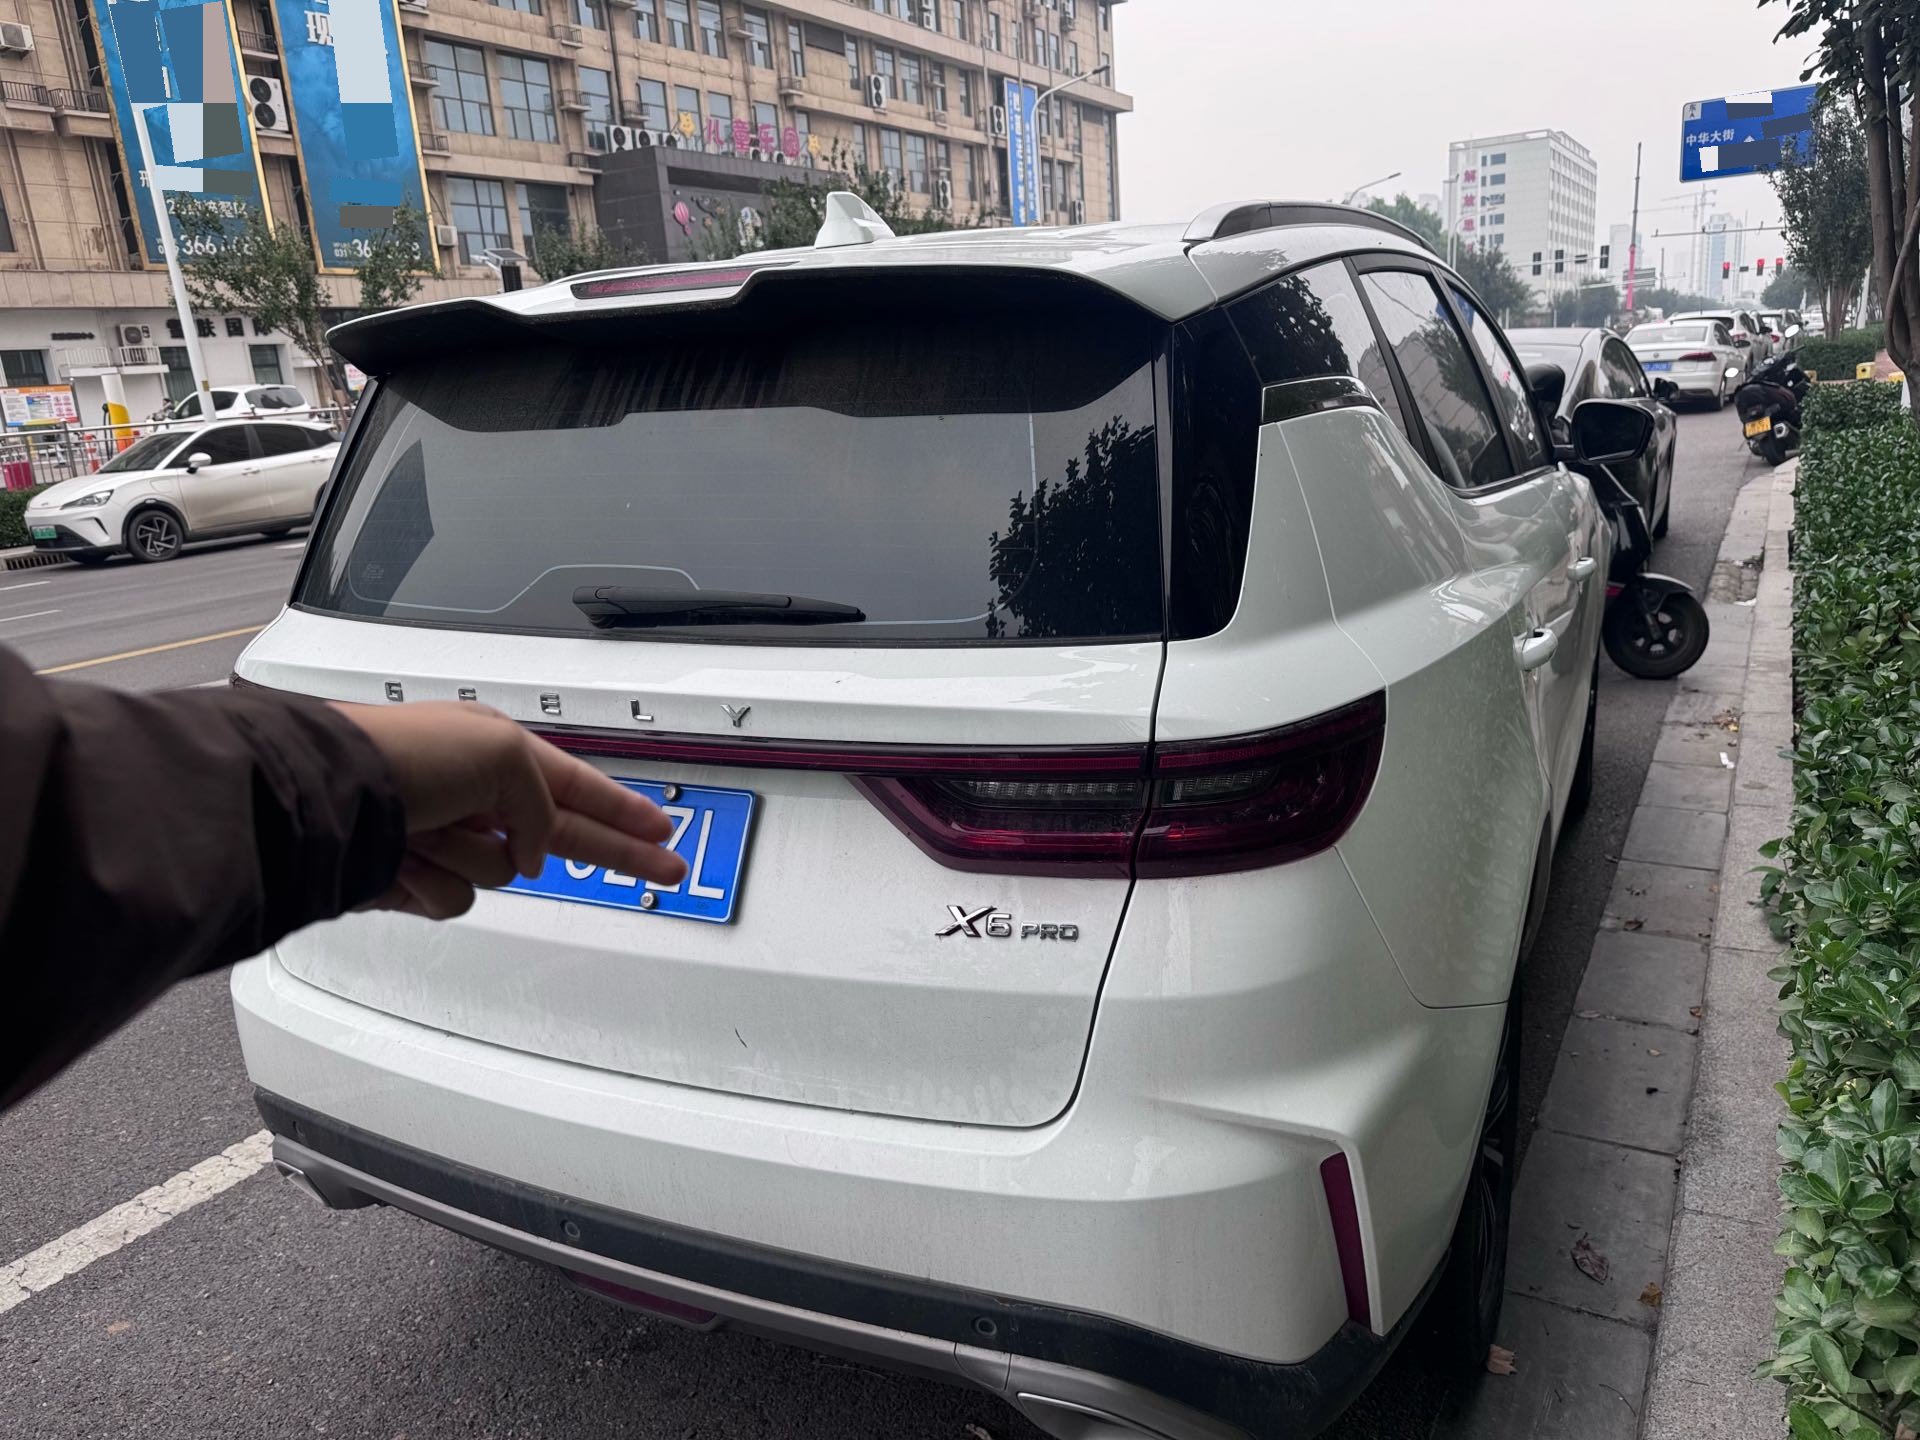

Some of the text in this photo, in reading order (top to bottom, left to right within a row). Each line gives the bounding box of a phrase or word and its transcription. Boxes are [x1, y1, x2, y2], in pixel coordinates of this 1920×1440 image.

[706, 117, 800, 158] 儿童乐园
[1686, 129, 1735, 147] 中华大街
[935, 905, 1080, 941] X6 PRO
